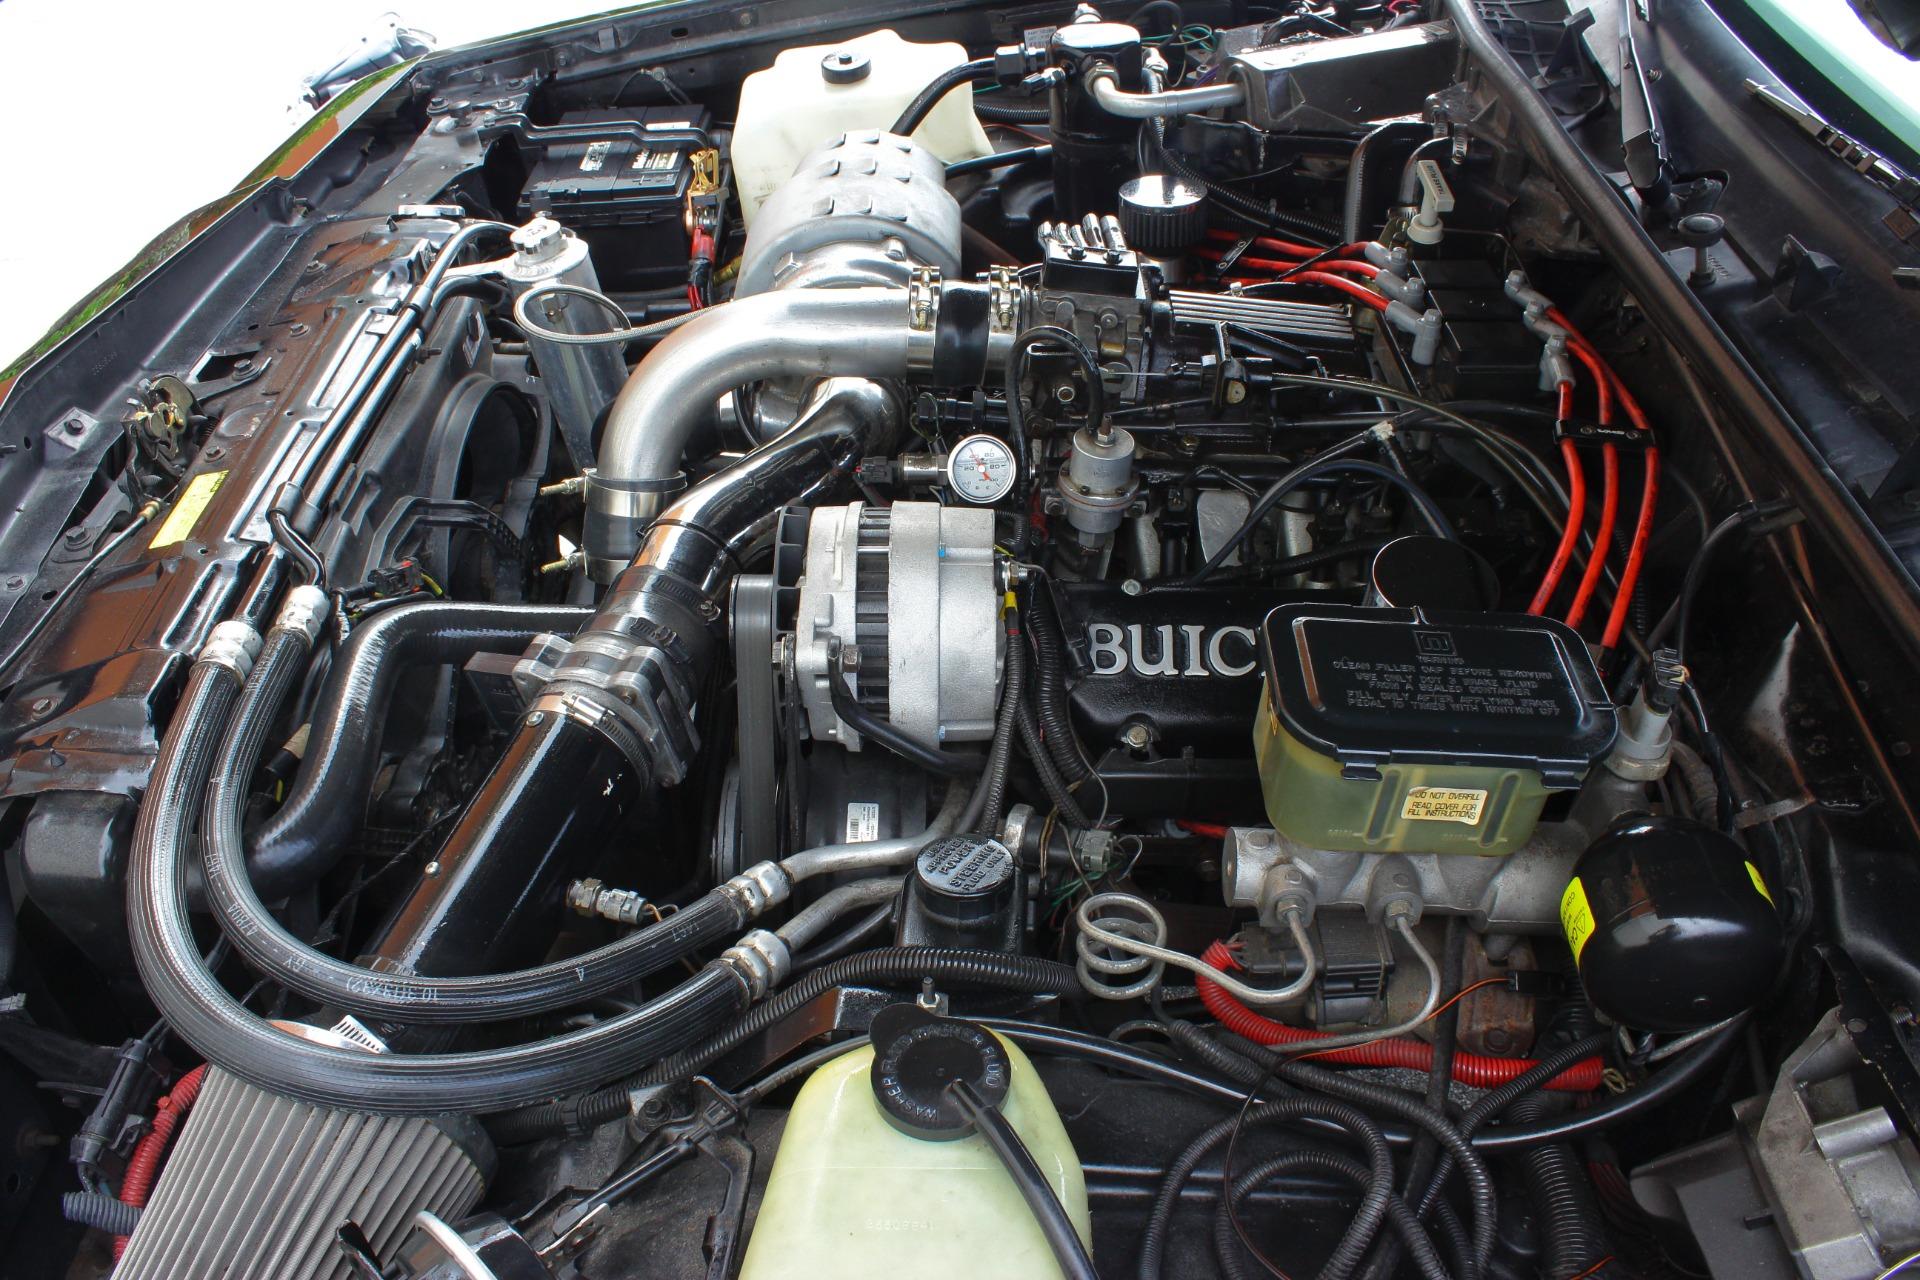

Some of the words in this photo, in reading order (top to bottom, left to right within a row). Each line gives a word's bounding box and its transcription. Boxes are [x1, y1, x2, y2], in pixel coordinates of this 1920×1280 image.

[1088, 623, 1266, 677] BUIC
[1376, 663, 1417, 673] FILLER
[1449, 667, 1493, 676] BEFORE
[1355, 672, 1378, 681] USE
[1463, 678, 1499, 687] BRAKE
[1504, 680, 1539, 689] FLUID
[1368, 681, 1400, 690] FROM
[1405, 683, 1414, 691] A
[1419, 684, 1463, 693] SEALED
[1469, 686, 1532, 696] CONTAINER
[1347, 698, 1386, 708] PEDAL
[1415, 791, 1427, 799] DO
[1448, 792, 1480, 801] OVERFILL
[1407, 808, 1421, 816] FILL
[1425, 809, 1477, 820] INSTRUCTIONS
[1412, 801, 1432, 809] READ
[1434, 802, 1459, 811] COVER
[1462, 803, 1477, 811] FOR
[939, 843, 975, 875] POWER
[950, 845, 996, 887] STEERING
[962, 870, 986, 891] FLUID
[985, 849, 1007, 869] ONLY
[880, 1077, 937, 1121] WASHER
